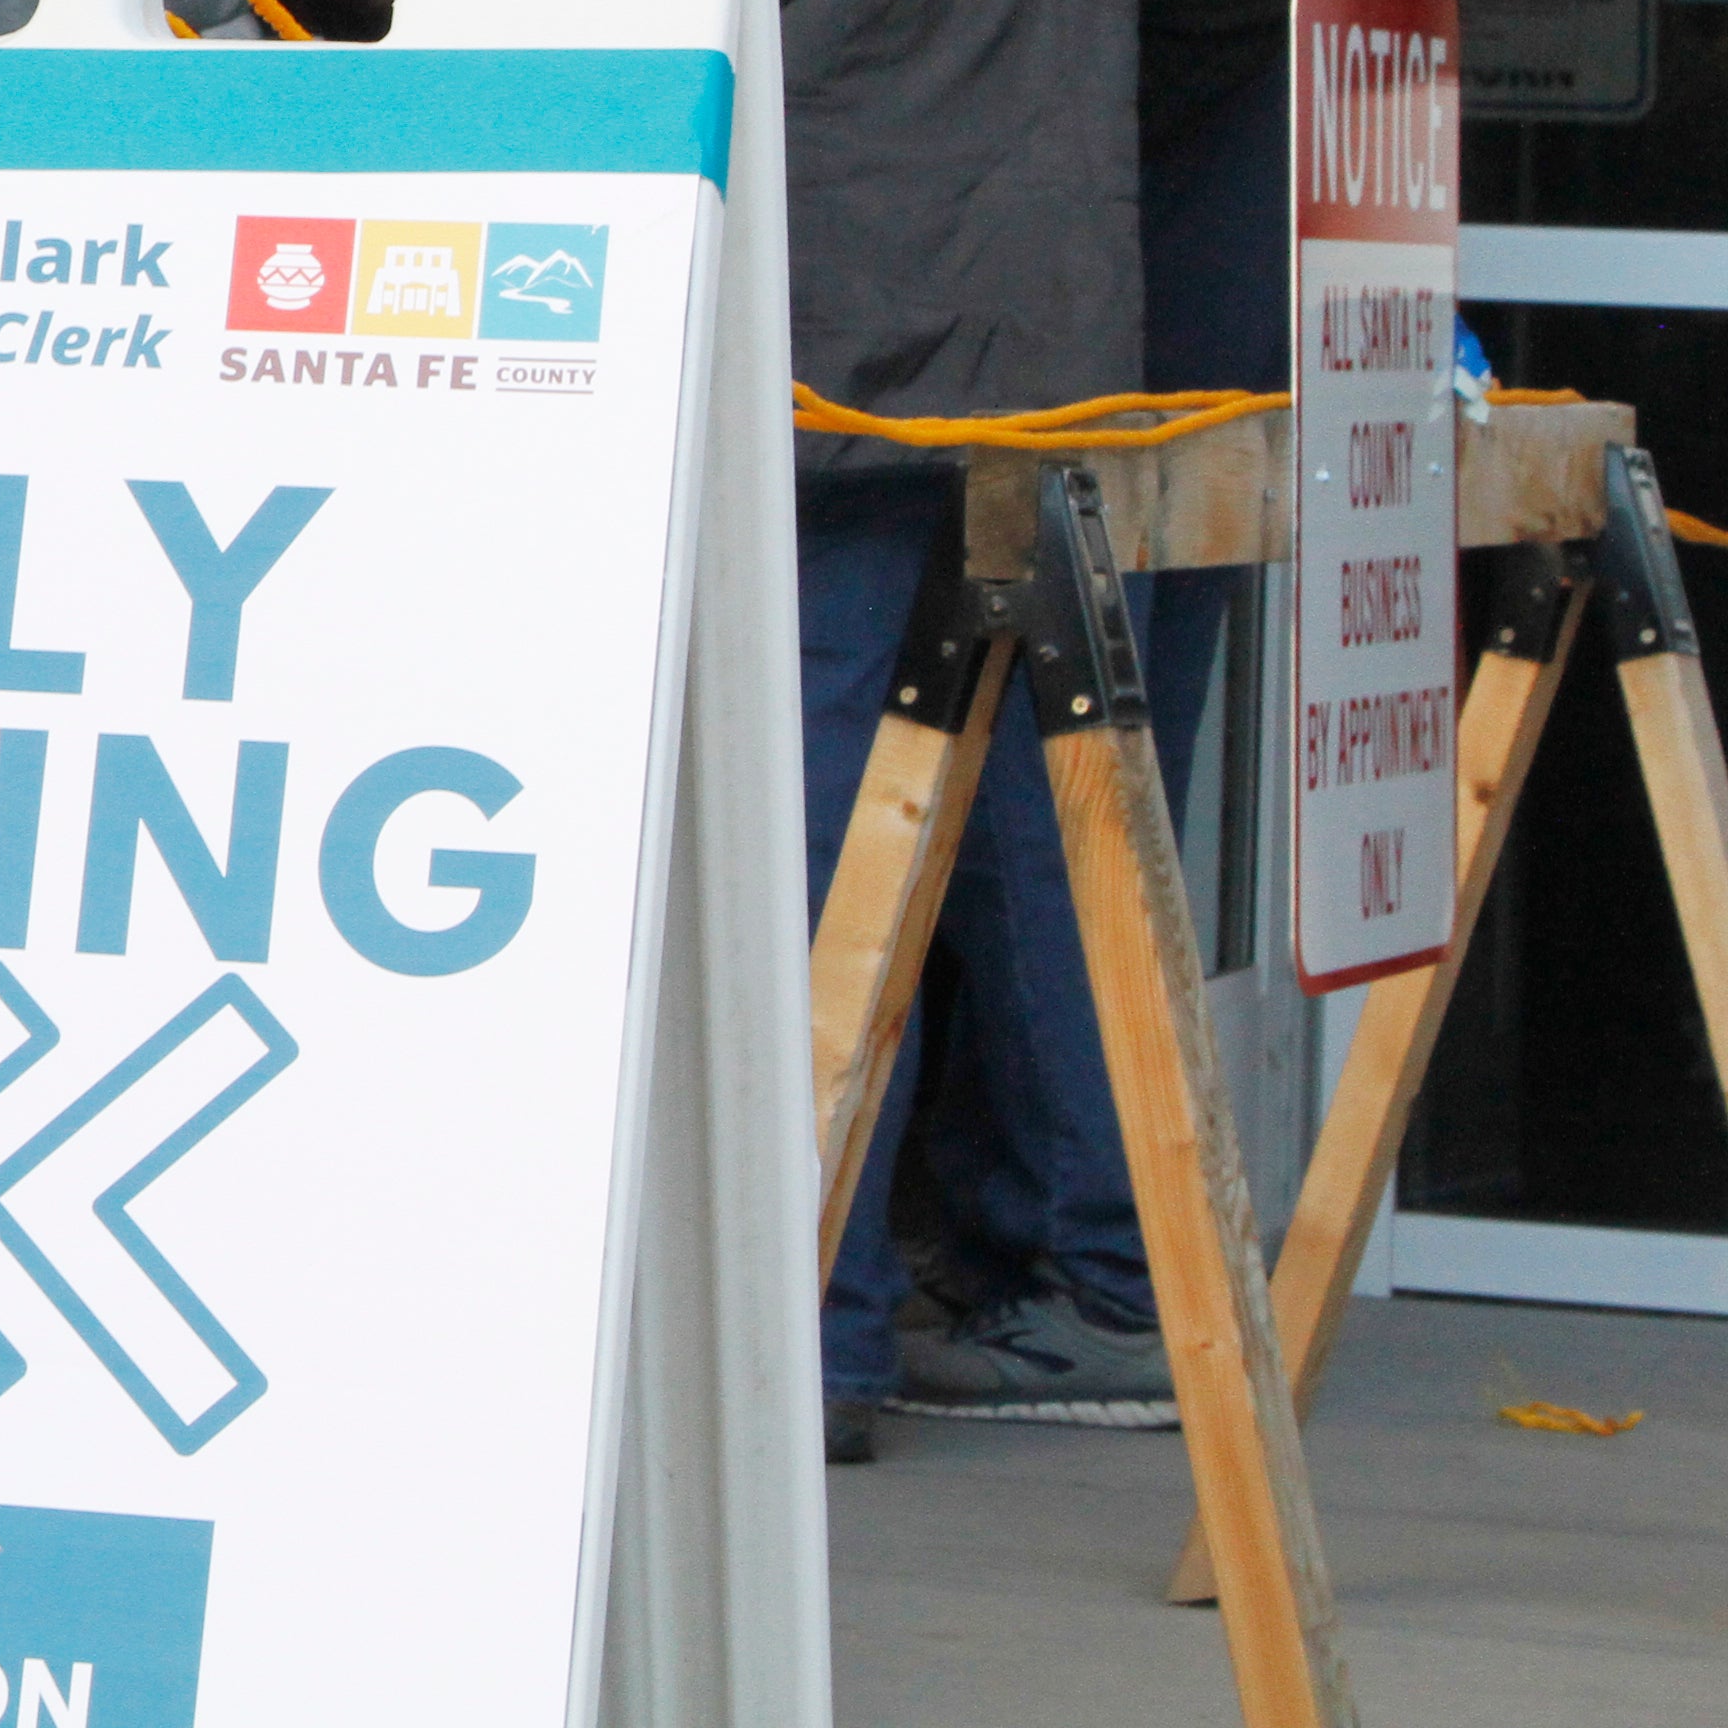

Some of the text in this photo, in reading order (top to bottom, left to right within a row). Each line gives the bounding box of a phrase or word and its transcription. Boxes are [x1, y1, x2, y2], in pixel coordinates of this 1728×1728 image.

[1312, 21, 1447, 212] NOTICE
[218, 346, 598, 391] SANTA FE COUNTY
[1321, 284, 1434, 371] ALL SANTA FE
[1348, 422, 1414, 510] COUNTY
[1341, 554, 1421, 648] BUSINESS
[1307, 685, 1449, 791] BY APPOINTMENT
[1360, 827, 1405, 920] ONLY
